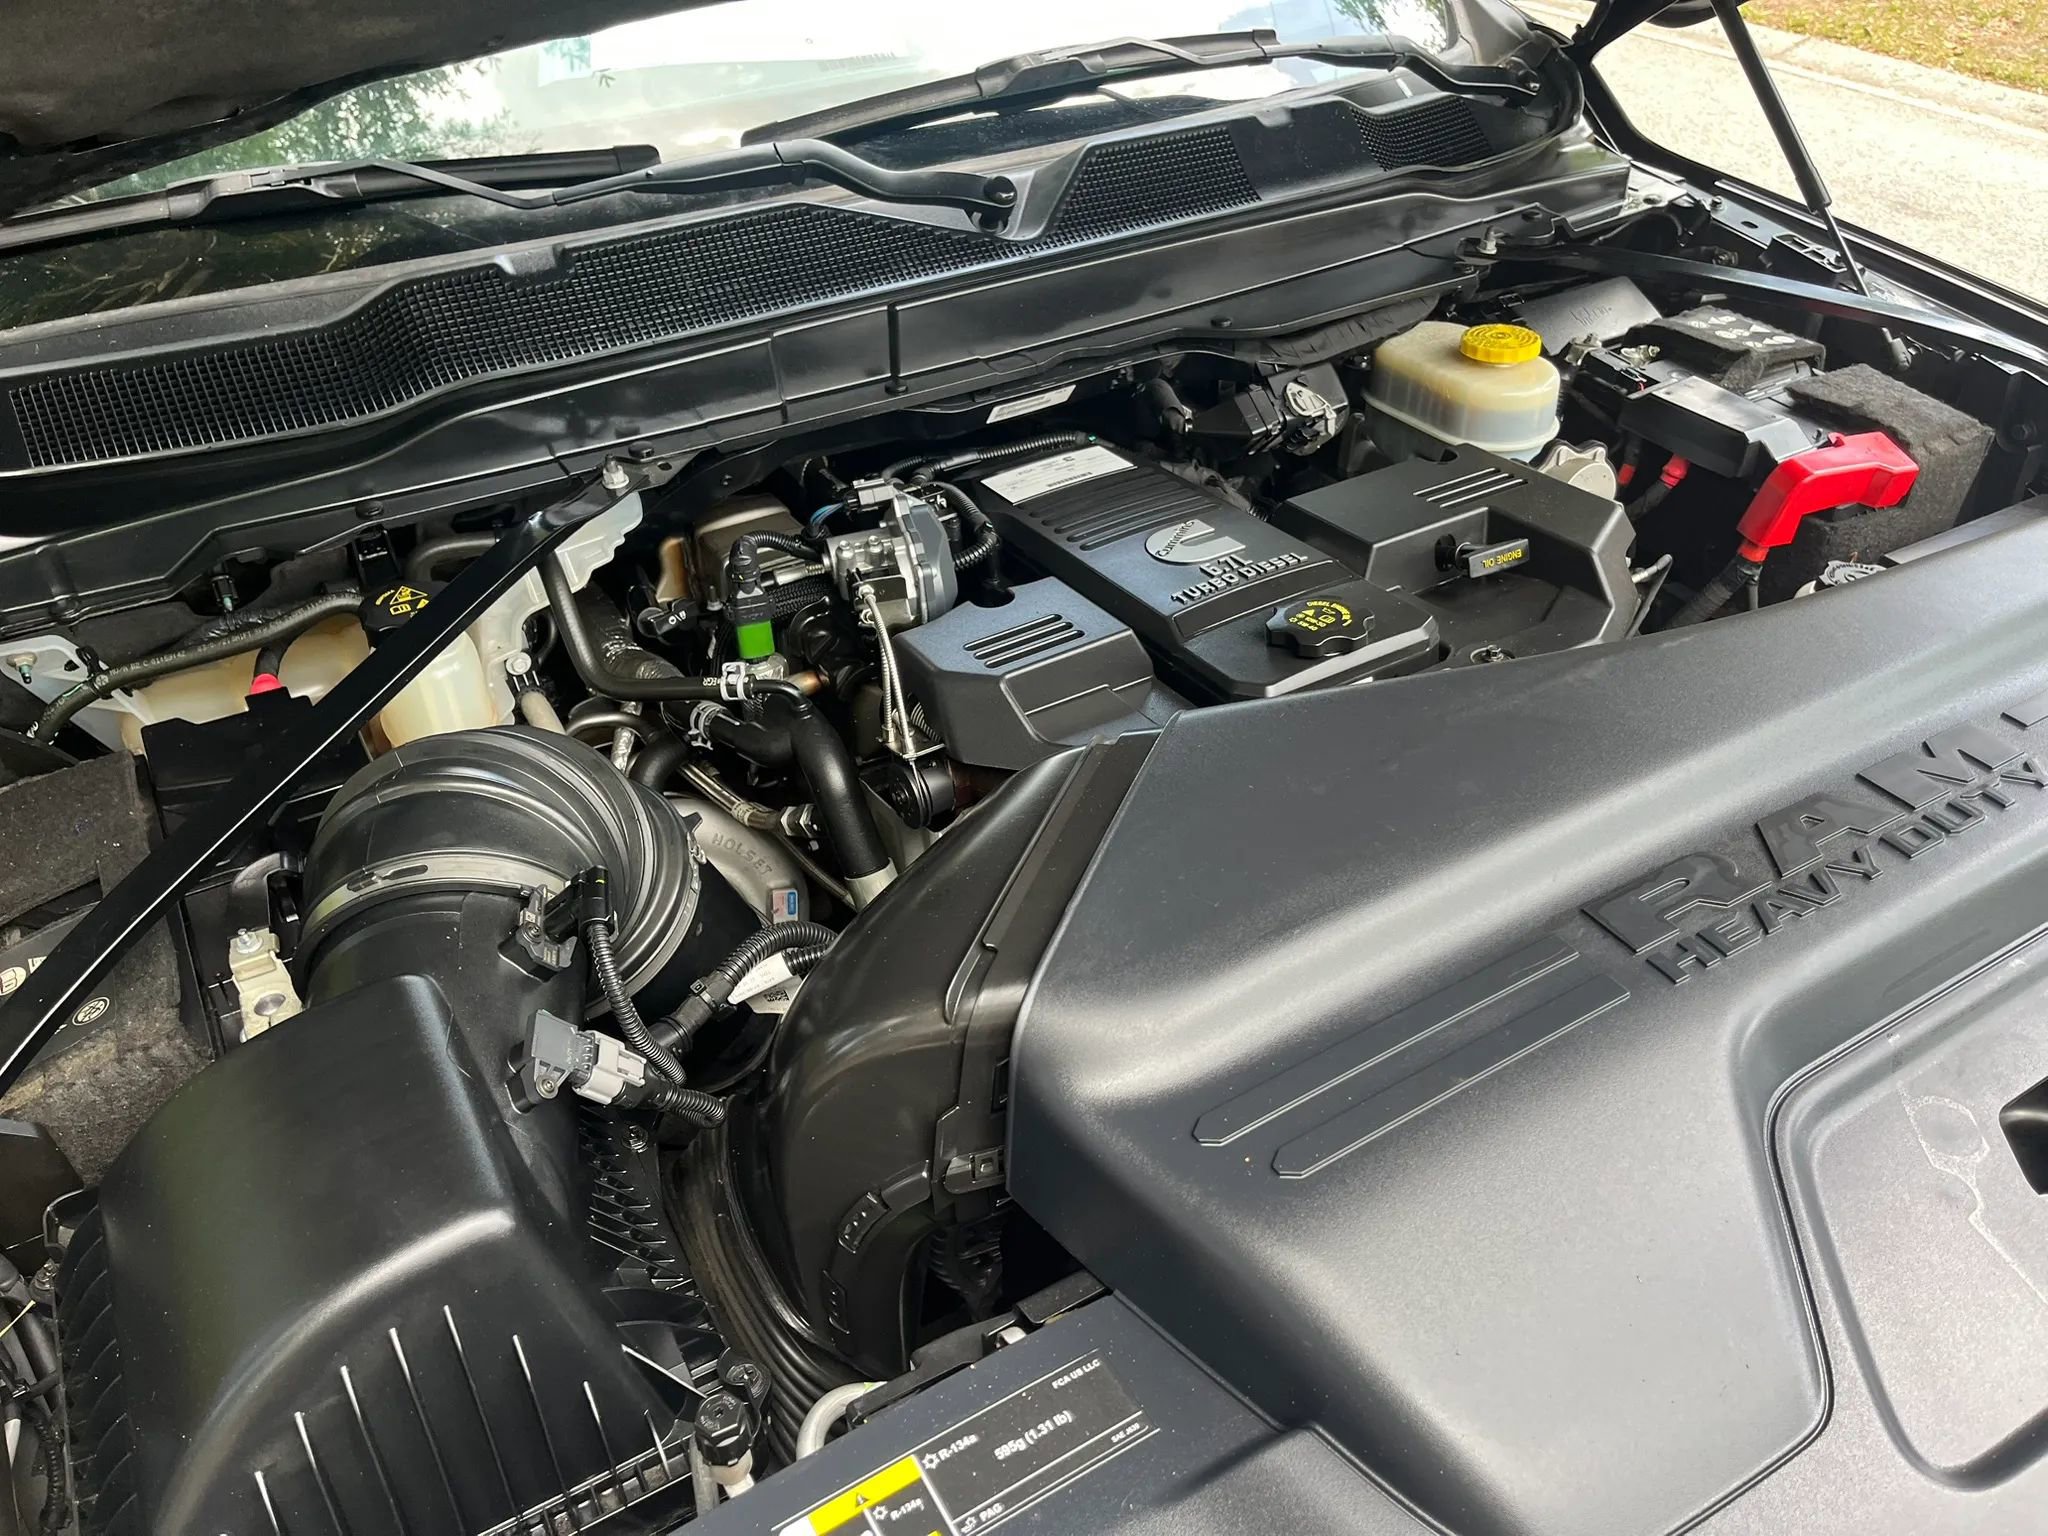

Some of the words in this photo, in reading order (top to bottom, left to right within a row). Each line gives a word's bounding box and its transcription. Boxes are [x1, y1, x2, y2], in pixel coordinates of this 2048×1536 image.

[1155, 519, 1195, 558] Cummins
[1200, 554, 1253, 578] 6.7L
[1482, 558, 1496, 568] OIL
[1496, 548, 1522, 564] ENGINE
[1171, 572, 1240, 605] TURBO
[1237, 552, 1308, 580] DIESEL
[702, 676, 718, 687] EGR
[1580, 722, 2025, 954] RAM
[711, 833, 773, 875] HOLSET
[1646, 845, 1884, 984] HEAVY
[1879, 756, 2048, 859] DUTY
[1051, 1374, 1071, 1390] FCA
[1070, 1367, 1084, 1380] US
[1082, 1358, 1101, 1373] LLC
[938, 1433, 979, 1461] R-134a
[994, 1438, 1028, 1460] 595g
[1024, 1419, 1055, 1445] (1.31
[1053, 1409, 1074, 1427] lb)
[1110, 1430, 1127, 1443] SAE
[978, 1502, 1005, 1522] PAG
